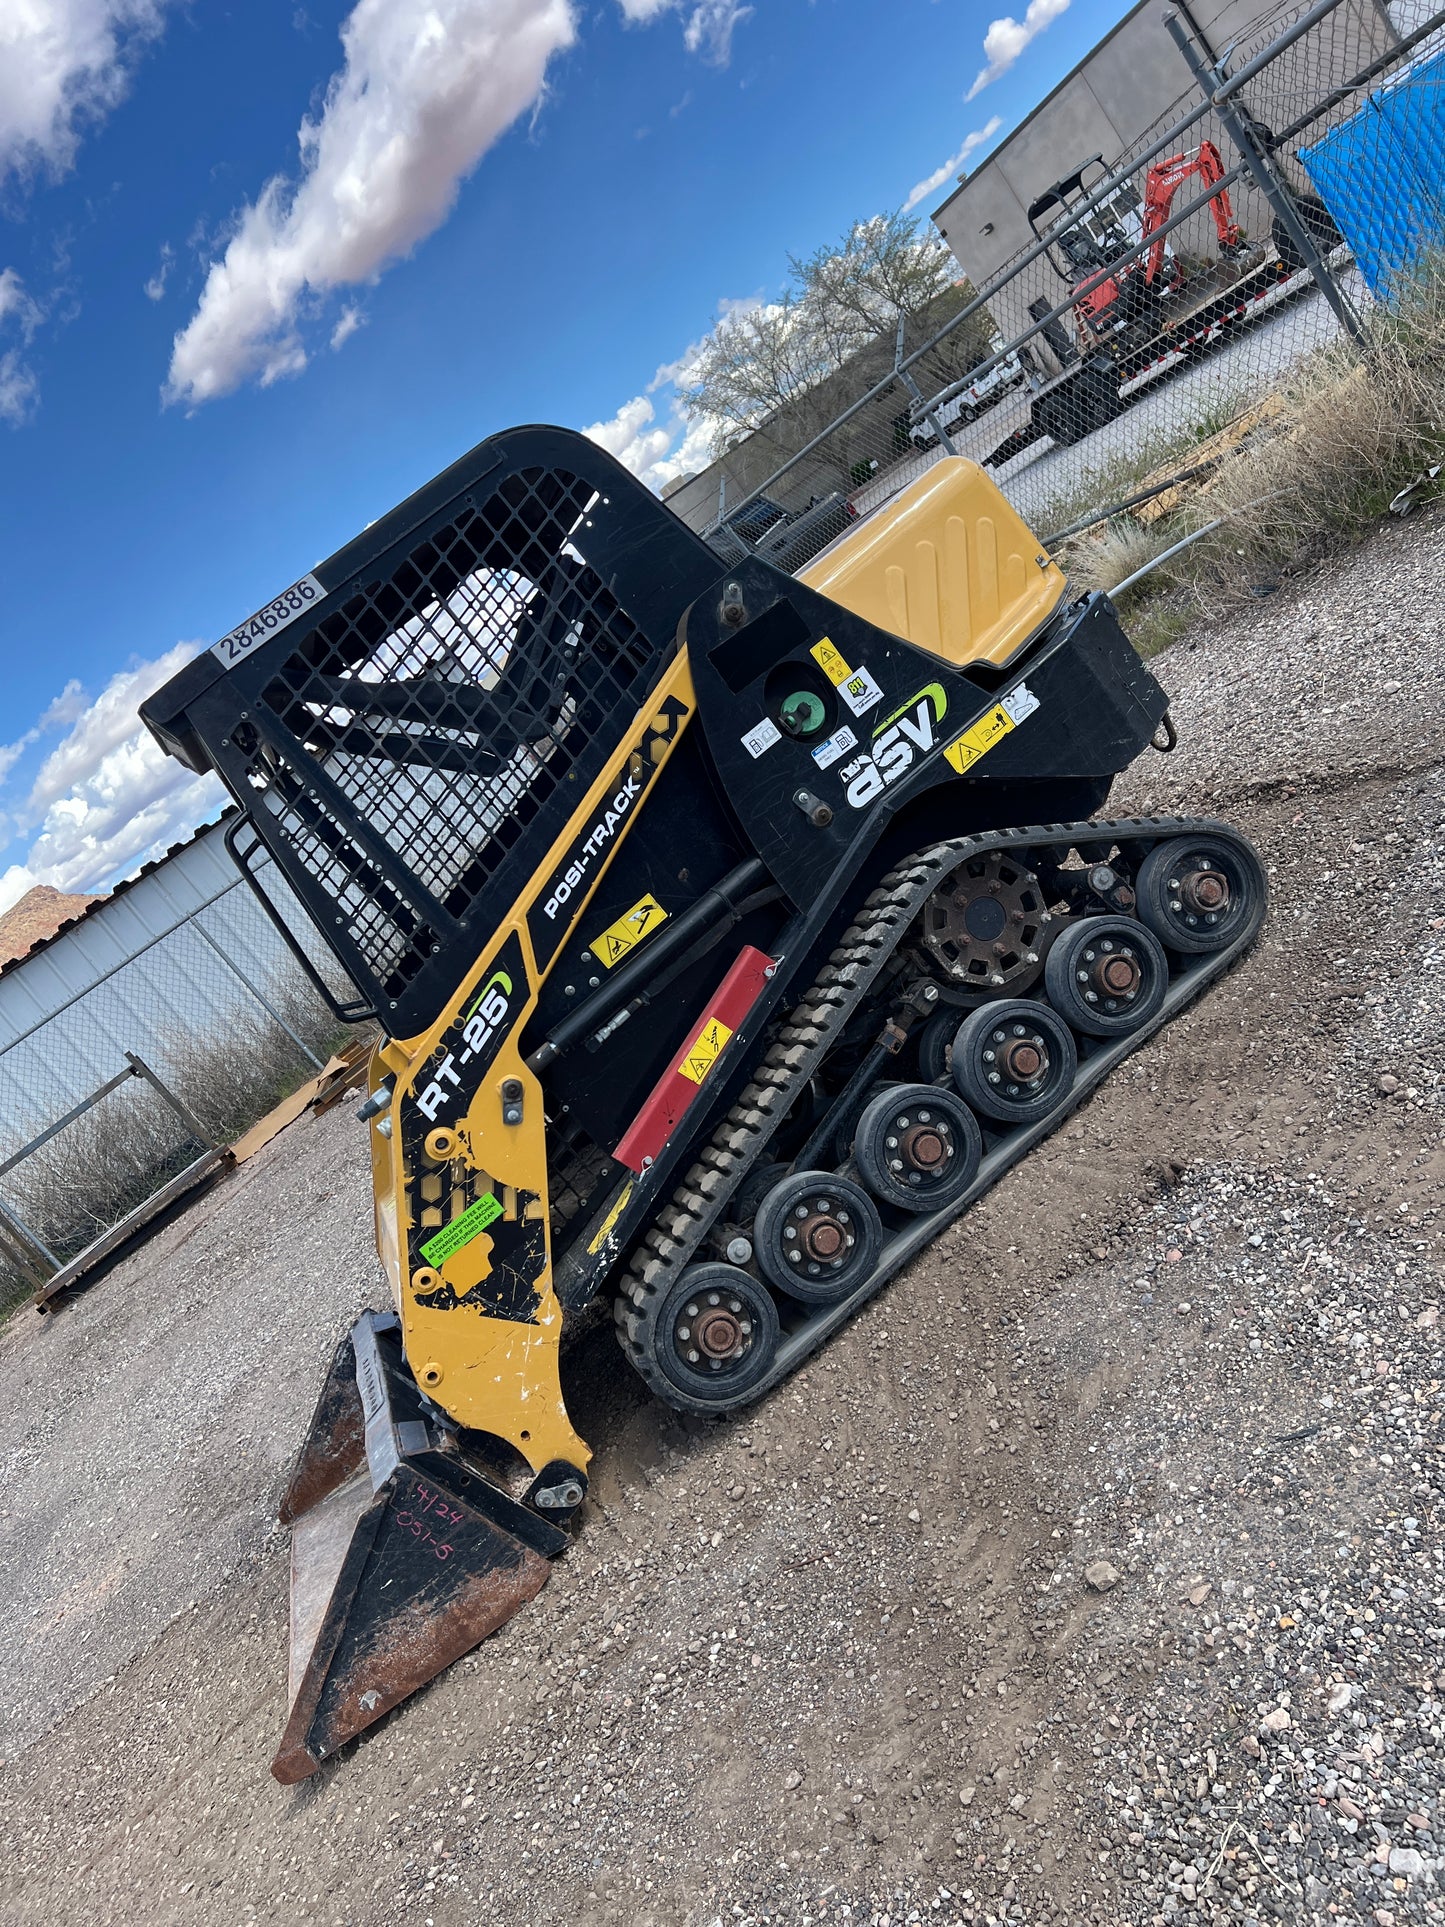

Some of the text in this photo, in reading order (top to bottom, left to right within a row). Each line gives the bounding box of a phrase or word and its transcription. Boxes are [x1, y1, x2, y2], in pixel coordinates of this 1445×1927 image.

[220, 581, 315, 660] 2846886
[847, 677, 865, 695] 811
[544, 775, 641, 920] POSI-TRACK
[416, 988, 509, 1122] RT-25
[435, 1234, 458, 1253] CHARGED
[463, 1219, 475, 1229] THIS
[475, 1202, 496, 1220] MACHINE
[443, 1218, 467, 1238] CLEANING
[467, 1210, 476, 1218] FEE
[476, 1201, 489, 1210] WILL
[443, 1245, 453, 1254] NOT
[453, 1225, 479, 1246] RETURNED
[479, 1211, 495, 1225] CLEAN
[417, 1484, 464, 1526] 4/24
